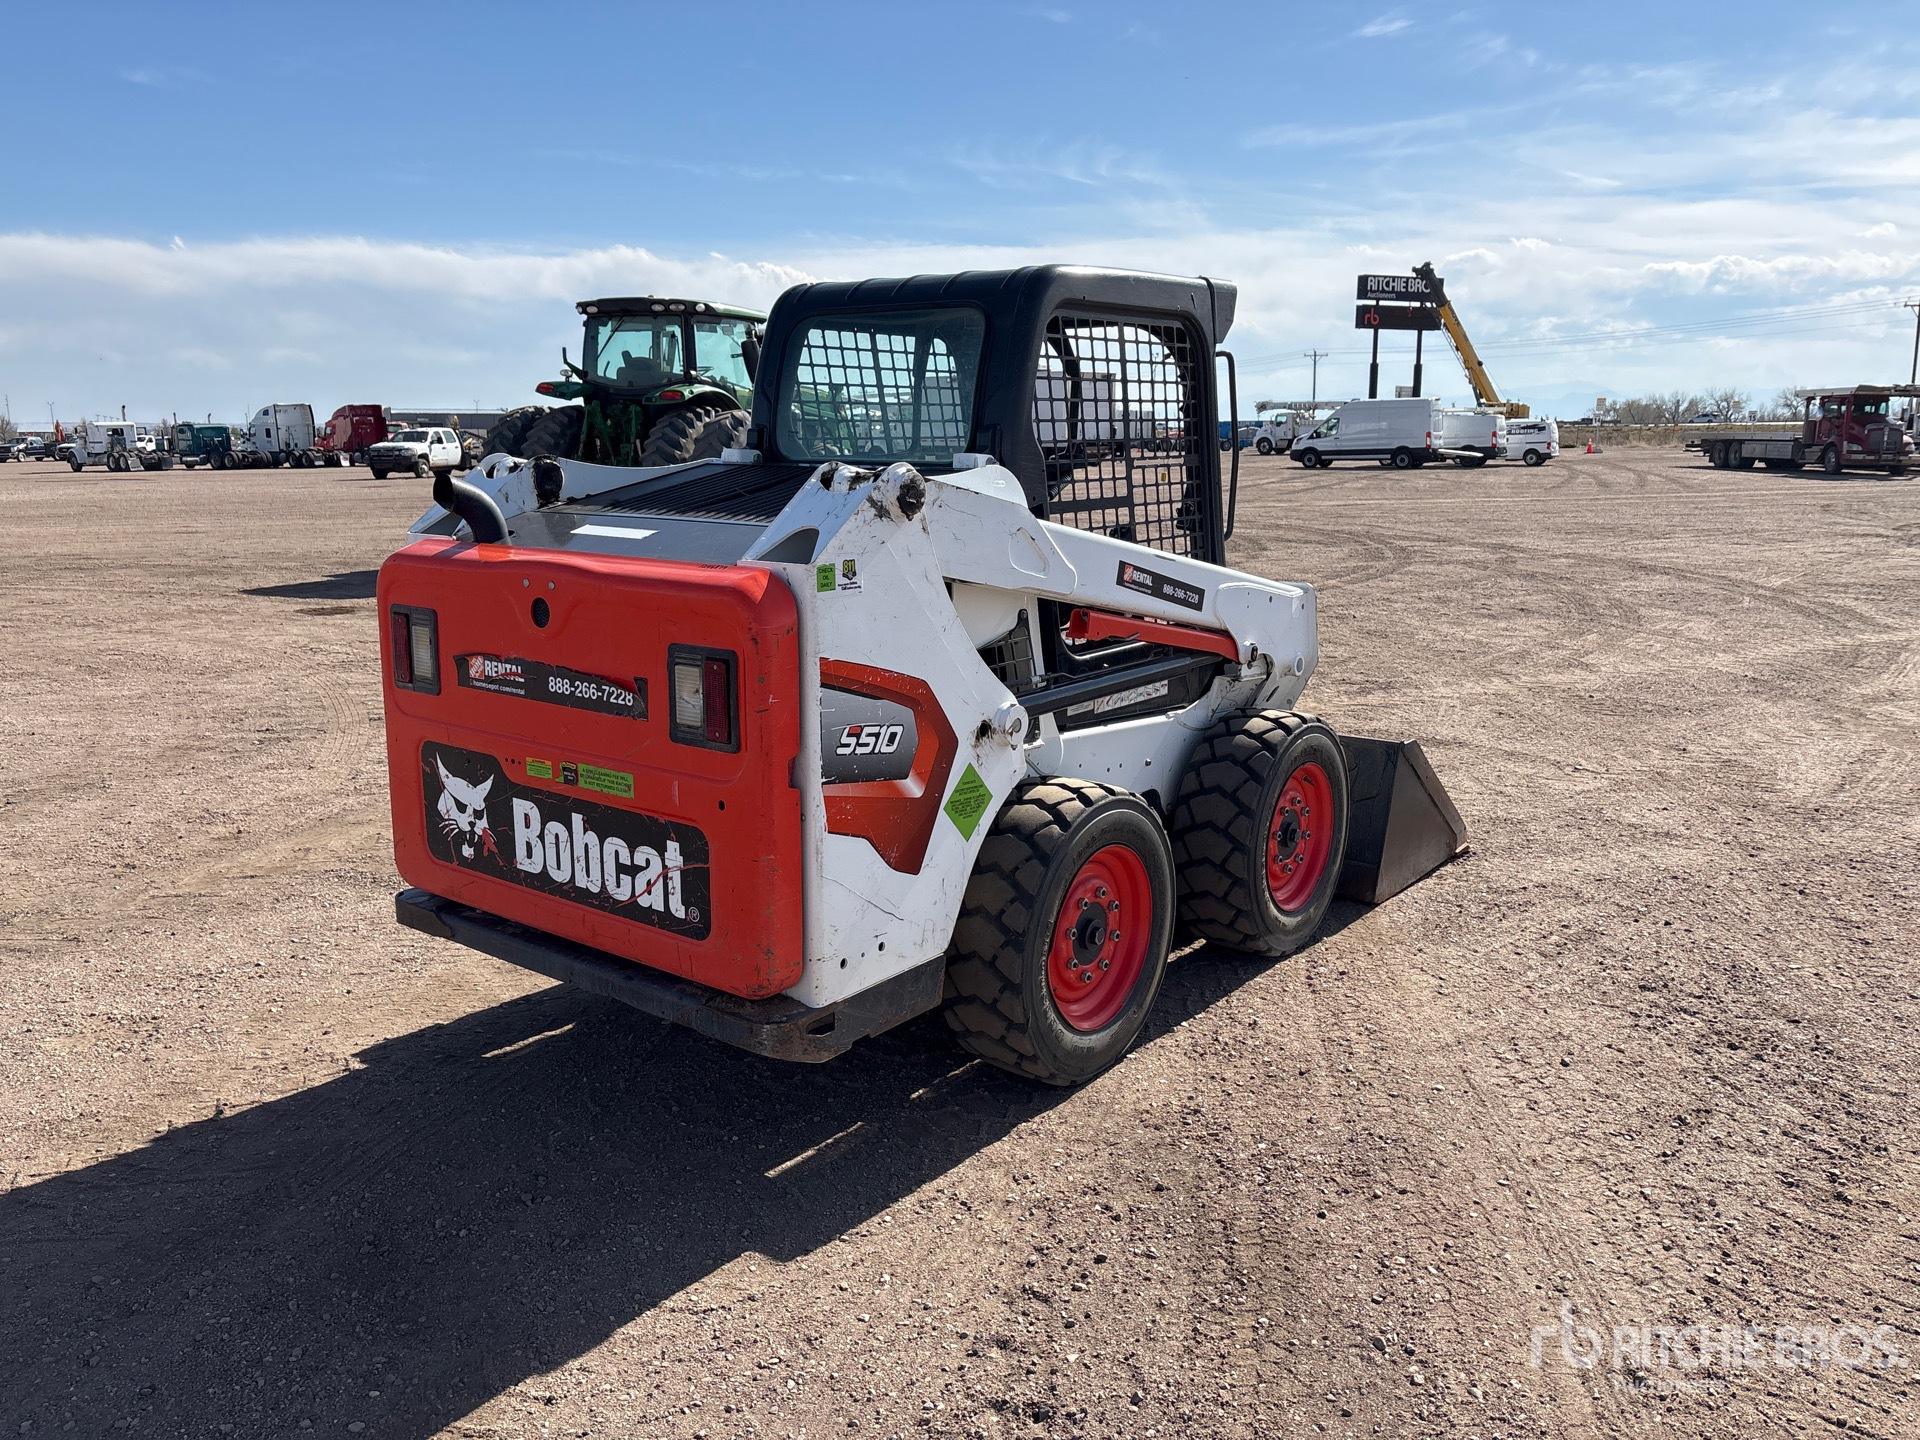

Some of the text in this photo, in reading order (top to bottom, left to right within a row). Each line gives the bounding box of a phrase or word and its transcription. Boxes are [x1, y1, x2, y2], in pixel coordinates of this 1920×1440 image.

[1367, 277, 1431, 293] RITCHIE BRO
[1367, 291, 1396, 299] Auctioneers
[1364, 307, 1380, 325] rb
[843, 559, 855, 573] 811
[1132, 570, 1153, 586] RENTAL
[1162, 583, 1199, 604] 888-266-7228
[484, 660, 525, 683] RENTAL
[548, 676, 634, 706] 888-266-7228
[836, 724, 904, 755] S510
[512, 797, 686, 920] Bobcat
